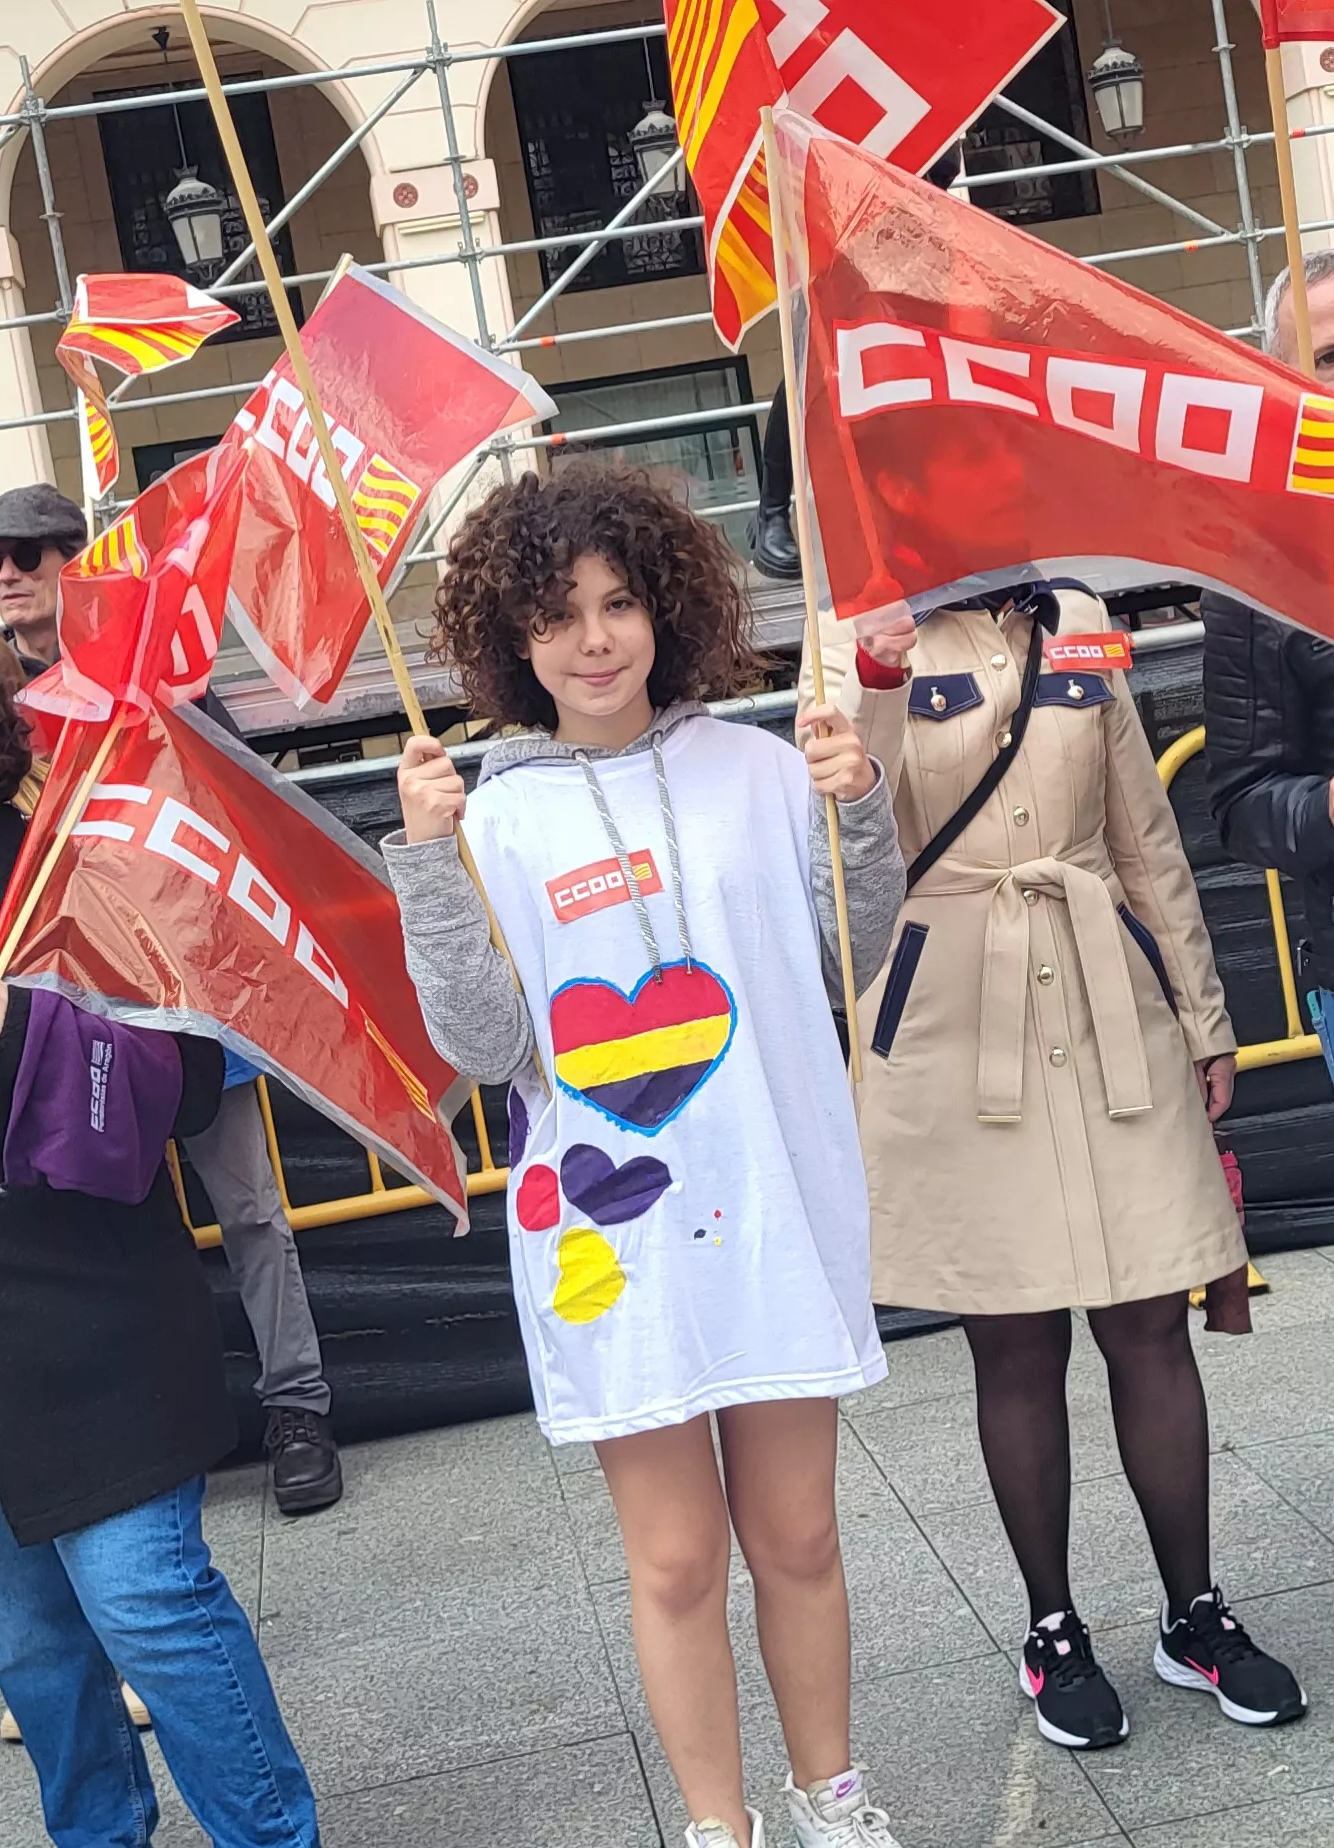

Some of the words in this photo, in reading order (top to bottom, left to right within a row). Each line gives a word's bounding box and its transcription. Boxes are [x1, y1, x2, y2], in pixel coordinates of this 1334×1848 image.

[836, 322, 1264, 483] CCOO
[1049, 645, 1104, 659] CCOO
[56, 772, 349, 1009] CCOO
[554, 870, 625, 909] CCOO
[90, 1065, 101, 1132] CCOO
